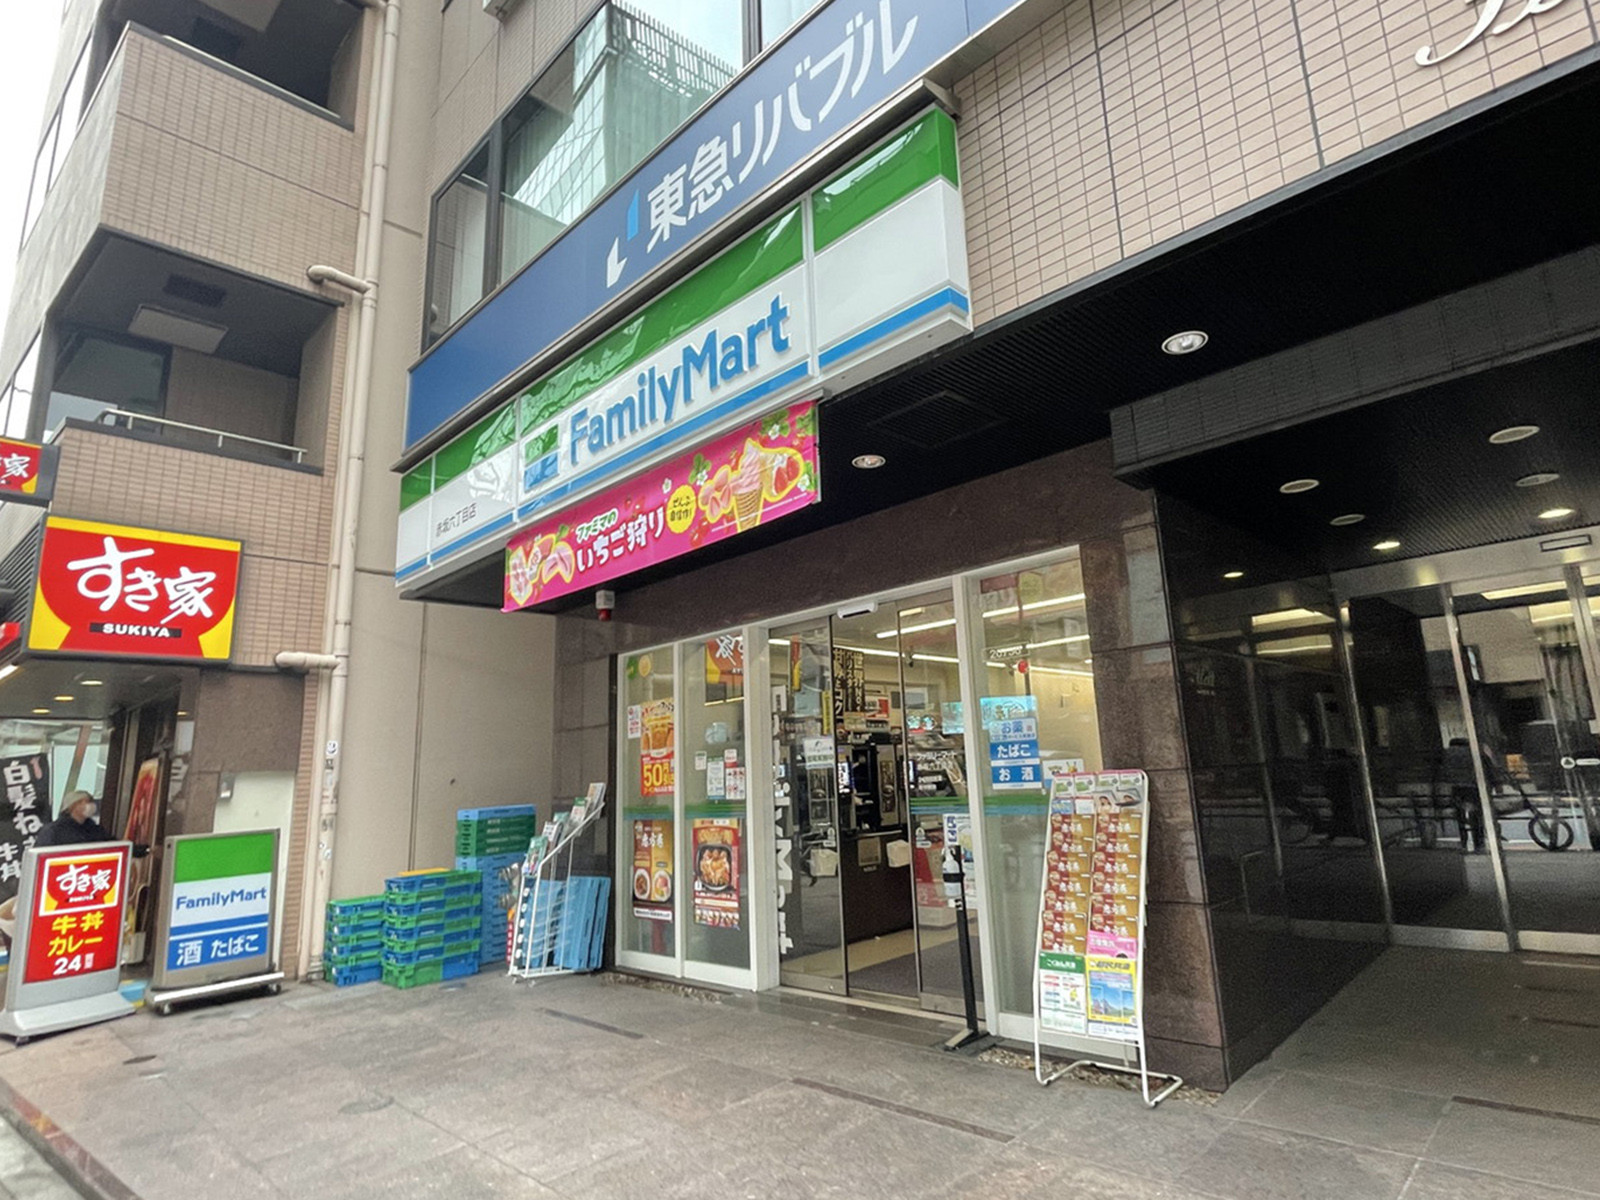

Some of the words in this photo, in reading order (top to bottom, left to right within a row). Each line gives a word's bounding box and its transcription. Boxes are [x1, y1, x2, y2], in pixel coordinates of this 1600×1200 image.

[646, 0, 919, 253] 東急リバブル
[569, 293, 791, 467] FamilyMart
[0, 452, 31, 478] 家
[575, 508, 619, 544] ファミマの
[576, 506, 664, 572] いちご狩り
[67, 536, 216, 625] すき家
[102, 622, 170, 638] SUKIYA
[997, 743, 1031, 758] たばこ
[56, 864, 112, 896] すき家
[175, 887, 267, 910] FamilyMart
[52, 911, 105, 935] 牛丼
[47, 935, 103, 957] カレー
[176, 940, 203, 966] 酒
[210, 934, 259, 959] たばこ
